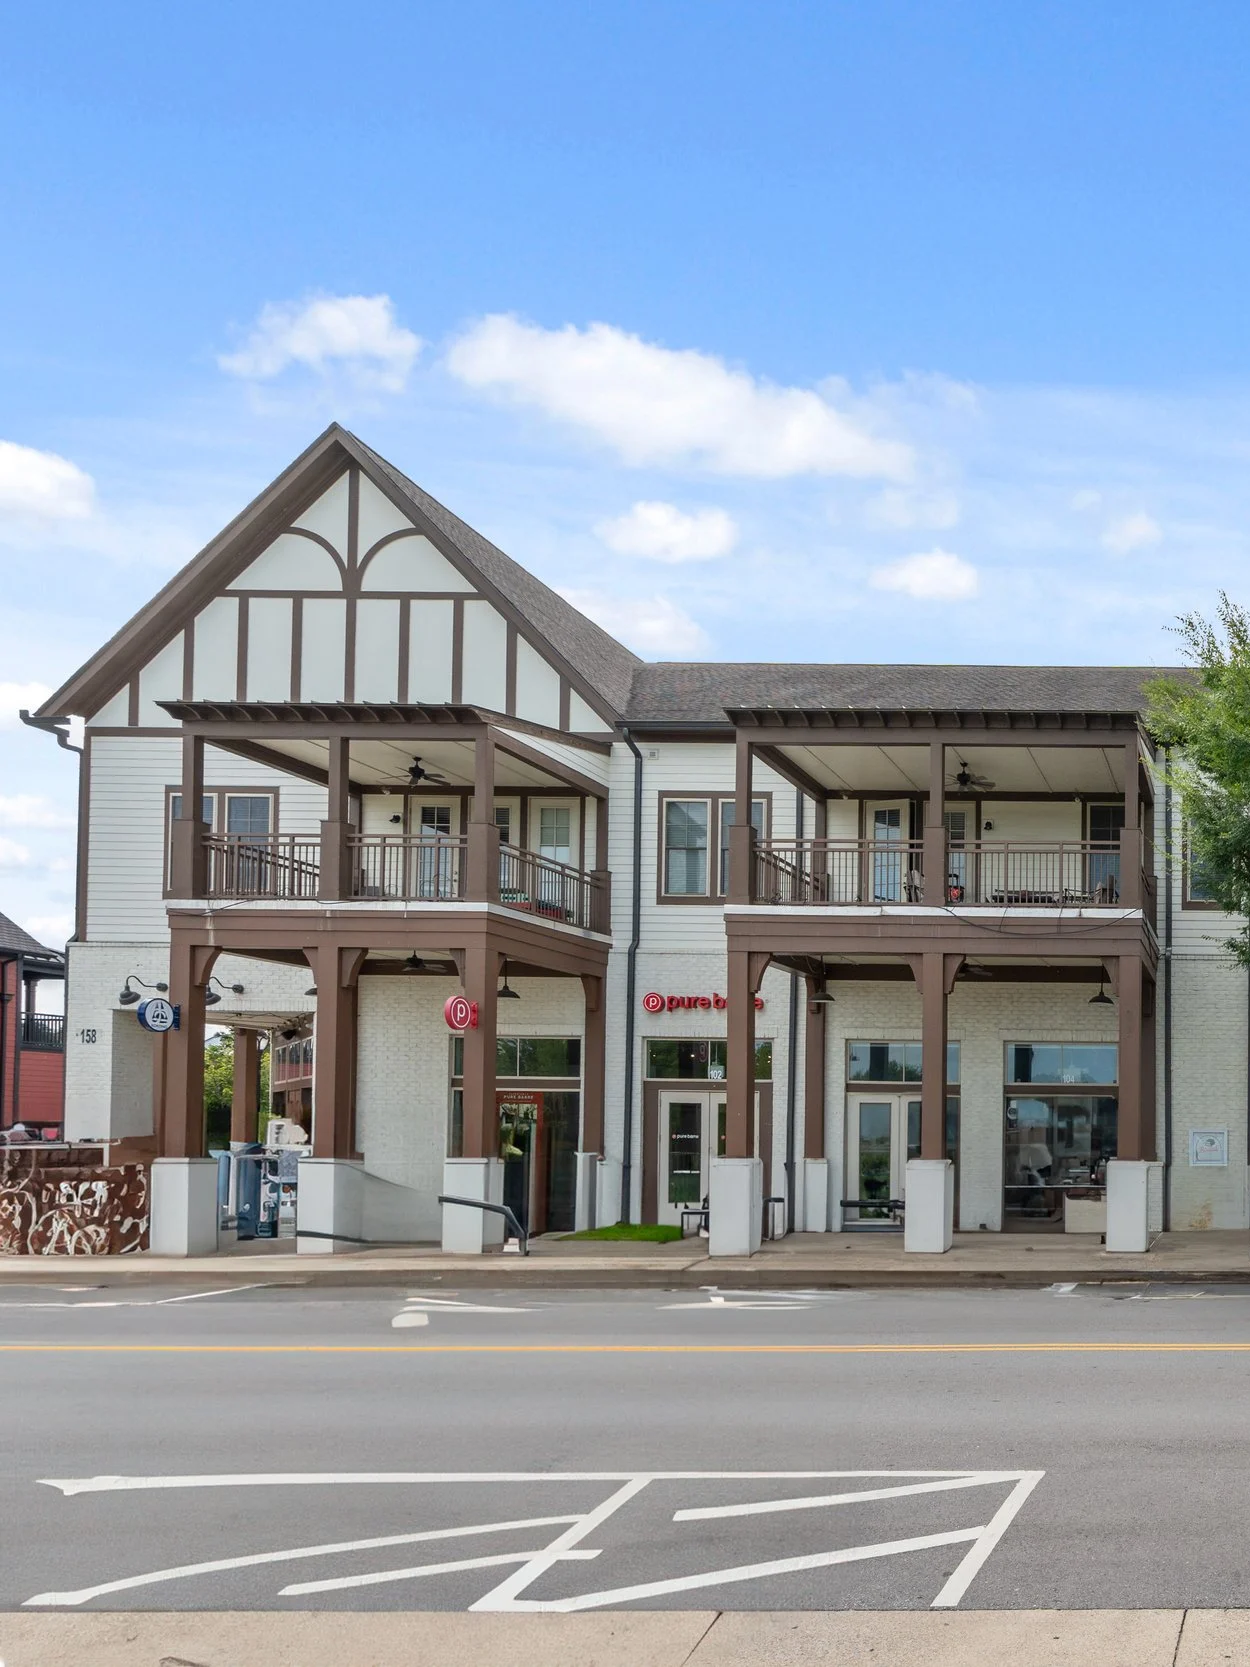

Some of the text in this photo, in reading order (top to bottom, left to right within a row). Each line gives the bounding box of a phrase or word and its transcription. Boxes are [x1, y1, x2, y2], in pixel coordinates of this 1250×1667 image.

[667, 996, 710, 1012] pure
[80, 1028, 97, 1044] 158
[710, 1070, 723, 1080] 102
